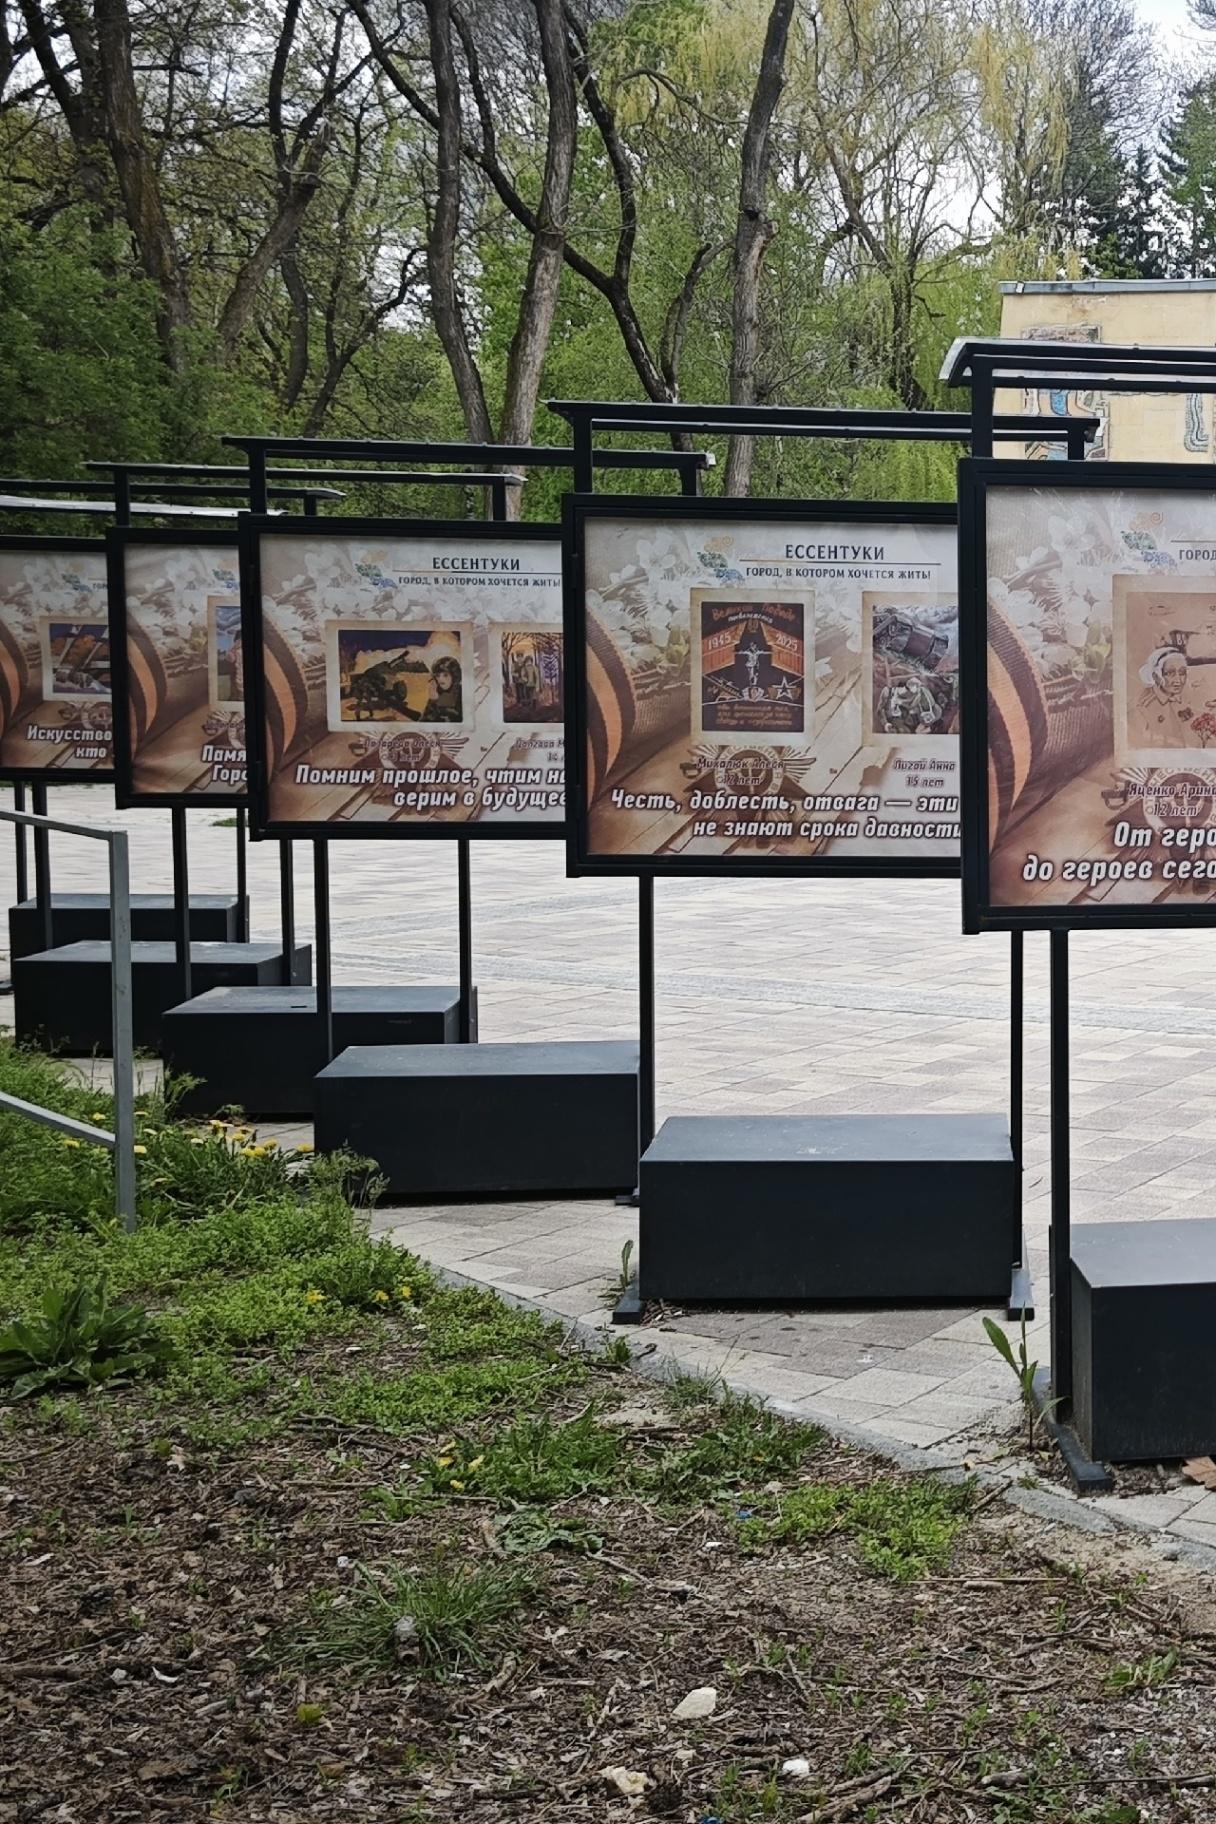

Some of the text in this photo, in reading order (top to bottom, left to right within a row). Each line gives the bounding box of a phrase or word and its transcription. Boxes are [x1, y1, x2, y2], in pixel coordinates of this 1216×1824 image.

[785, 545, 884, 560] ЕССЕНТУКИ
[432, 557, 520, 570] ЕССЕНТУКИ
[746, 567, 931, 580] ГОРОД, В КОТОРОМ ХОЧЕТСЯ ЖИТЬ!
[443, 578, 486, 586] КОТОРОМ
[488, 578, 529, 587] ХОЧЕТСЯ
[708, 631, 732, 651] 1945
[775, 633, 799, 652] 2025
[27, 724, 112, 743] Искусство
[76, 747, 107, 758] кто
[929, 758, 955, 771] Анна
[295, 764, 375, 784] Помним
[382, 769, 478, 788] прошлое,
[487, 769, 541, 783] чтим
[921, 777, 944, 788] лет
[1128, 782, 1175, 798] Яценко
[394, 791, 456, 810] верим
[463, 791, 475, 806] в
[611, 788, 682, 813] Честь,
[689, 789, 796, 813] доблесть,
[803, 796, 879, 811] отвага
[917, 796, 959, 811] эти
[1153, 803, 1198, 816] 12 лет
[693, 822, 717, 836] не
[724, 821, 793, 836] знают
[800, 822, 858, 840] срока
[1114, 822, 1151, 847] От
[1023, 855, 1054, 880] до
[1062, 859, 1152, 886] героев
